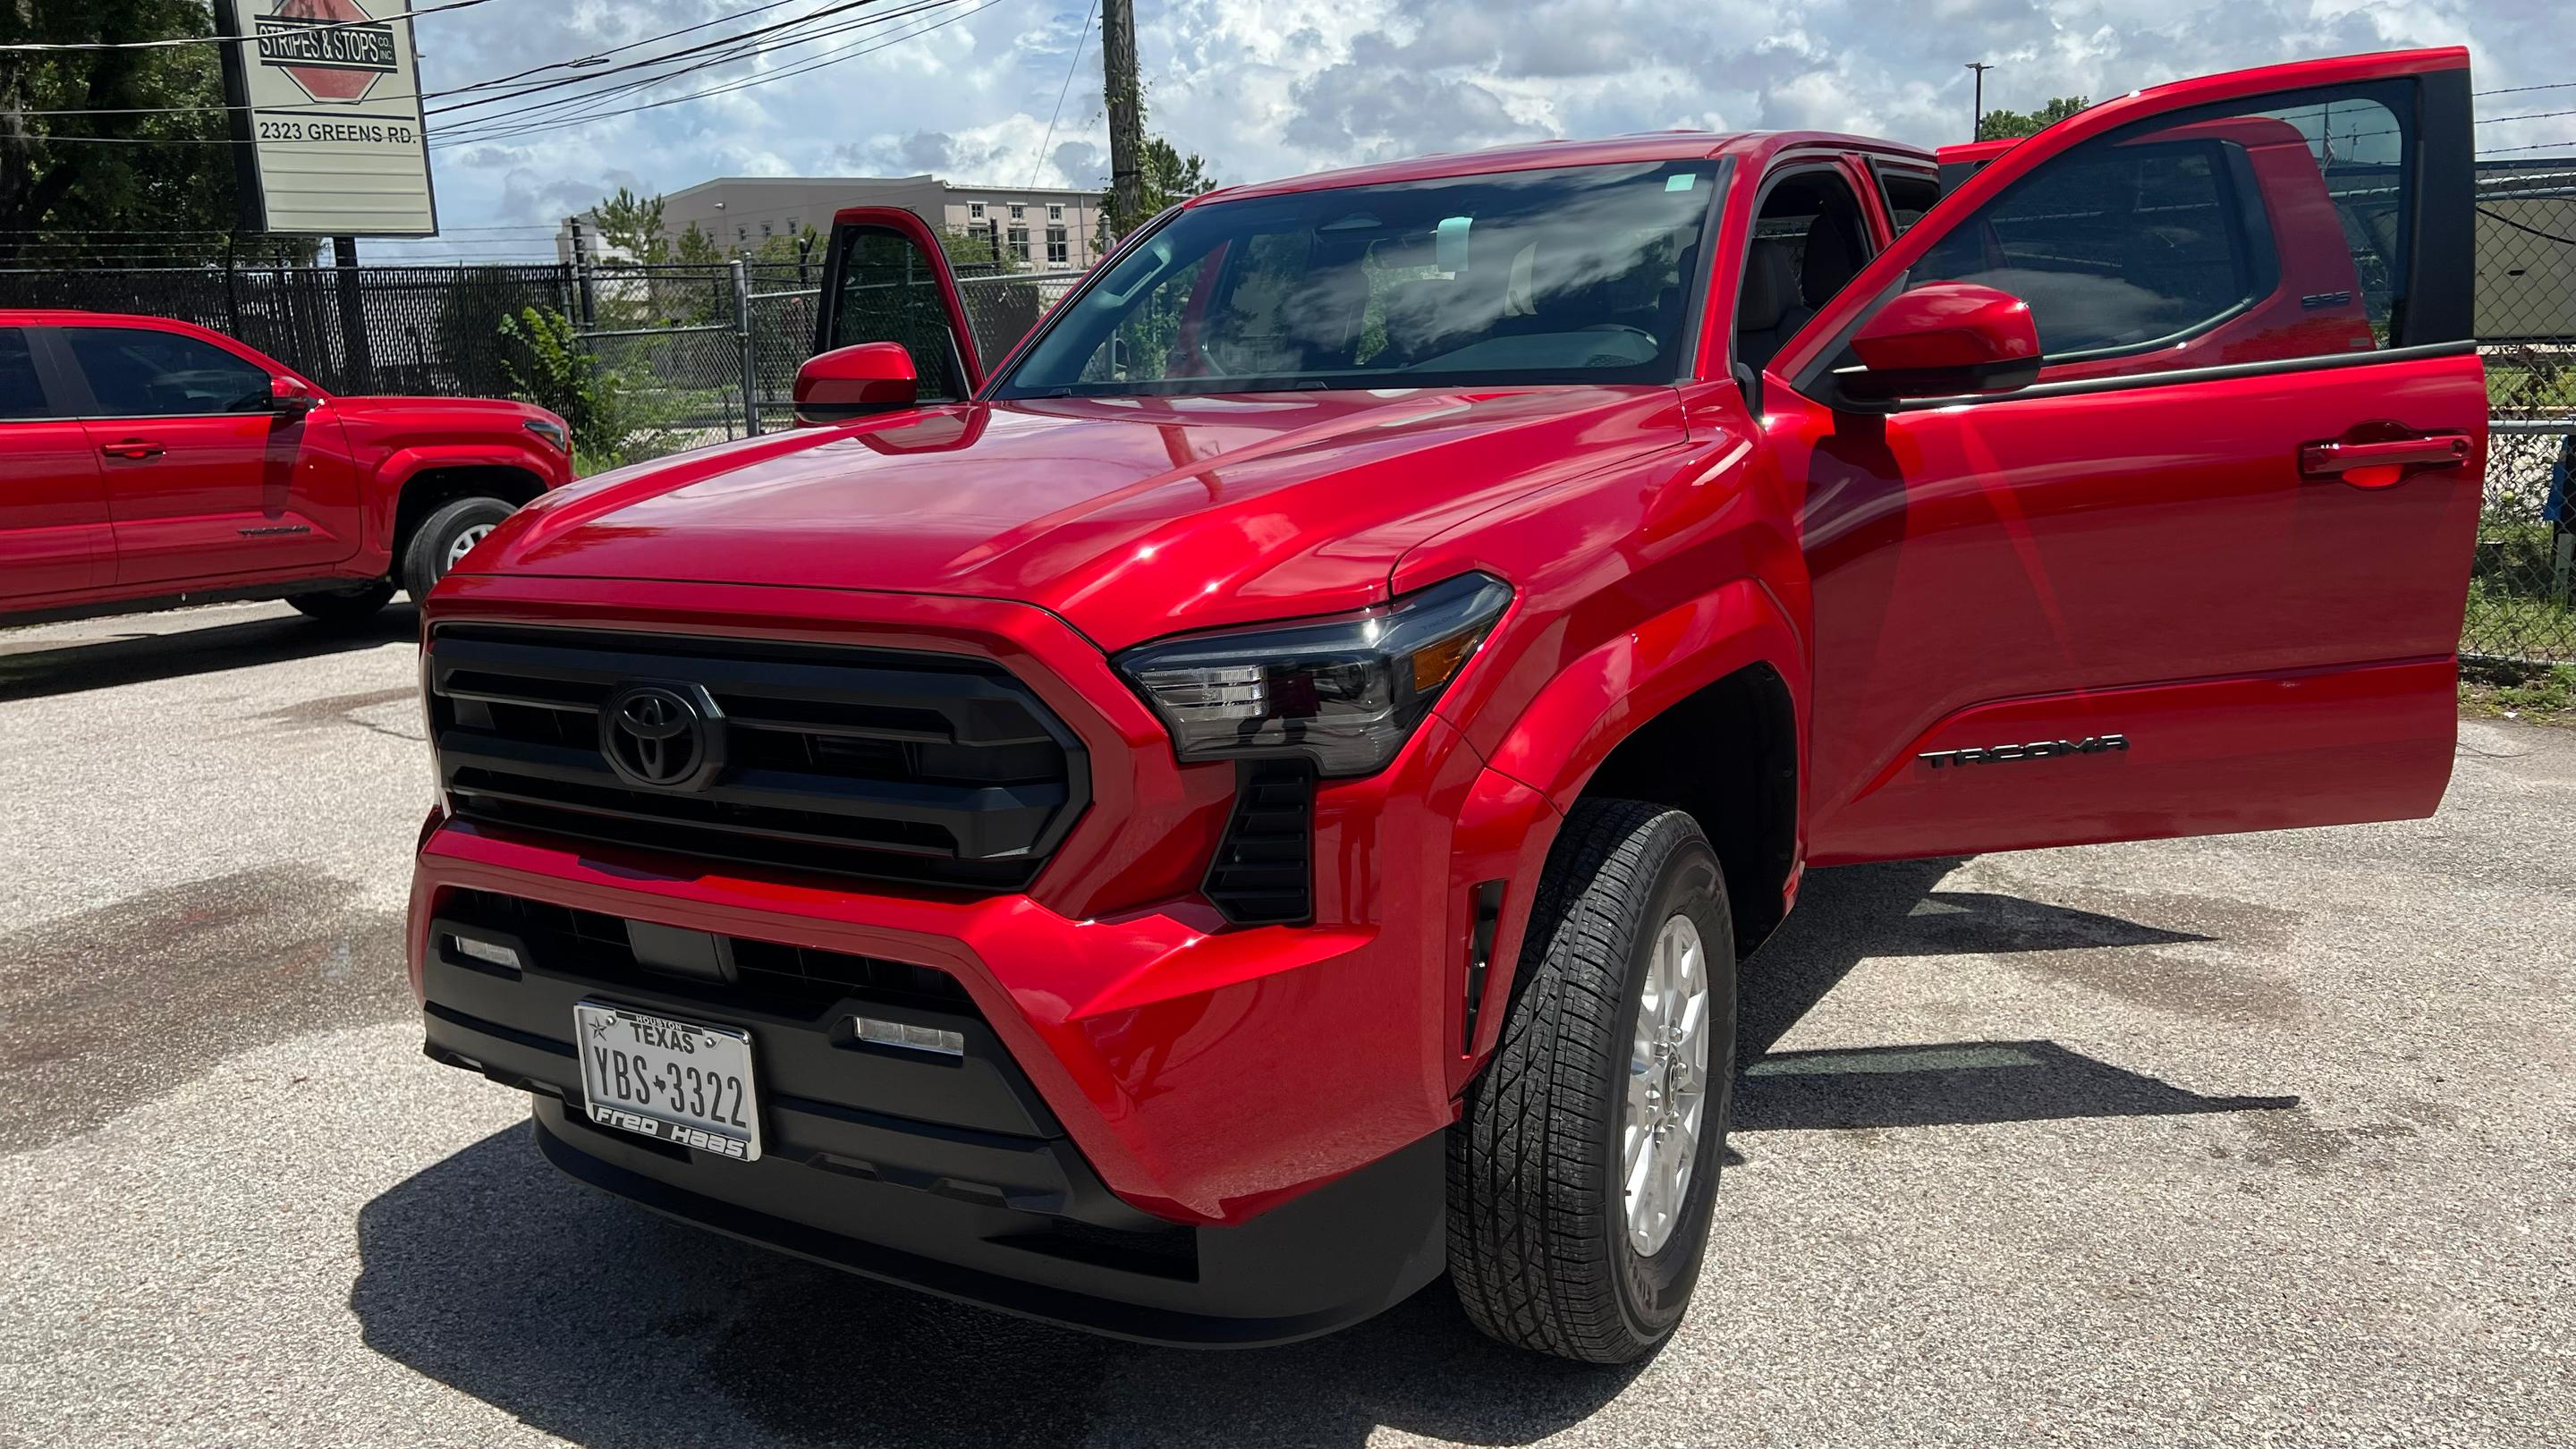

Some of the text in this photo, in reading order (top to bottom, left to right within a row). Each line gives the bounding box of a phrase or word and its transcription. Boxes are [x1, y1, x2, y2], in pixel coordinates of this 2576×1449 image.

[259, 25, 378, 63] STRIPES & STOPS
[380, 50, 394, 61] INC.
[259, 122, 417, 144] 2323 GREENS RD.
[1918, 733, 2130, 769] TACOMA
[630, 1021, 695, 1055] TEXAS
[636, 1015, 682, 1031] HOUSTON
[594, 1046, 747, 1128] YBS 3322
